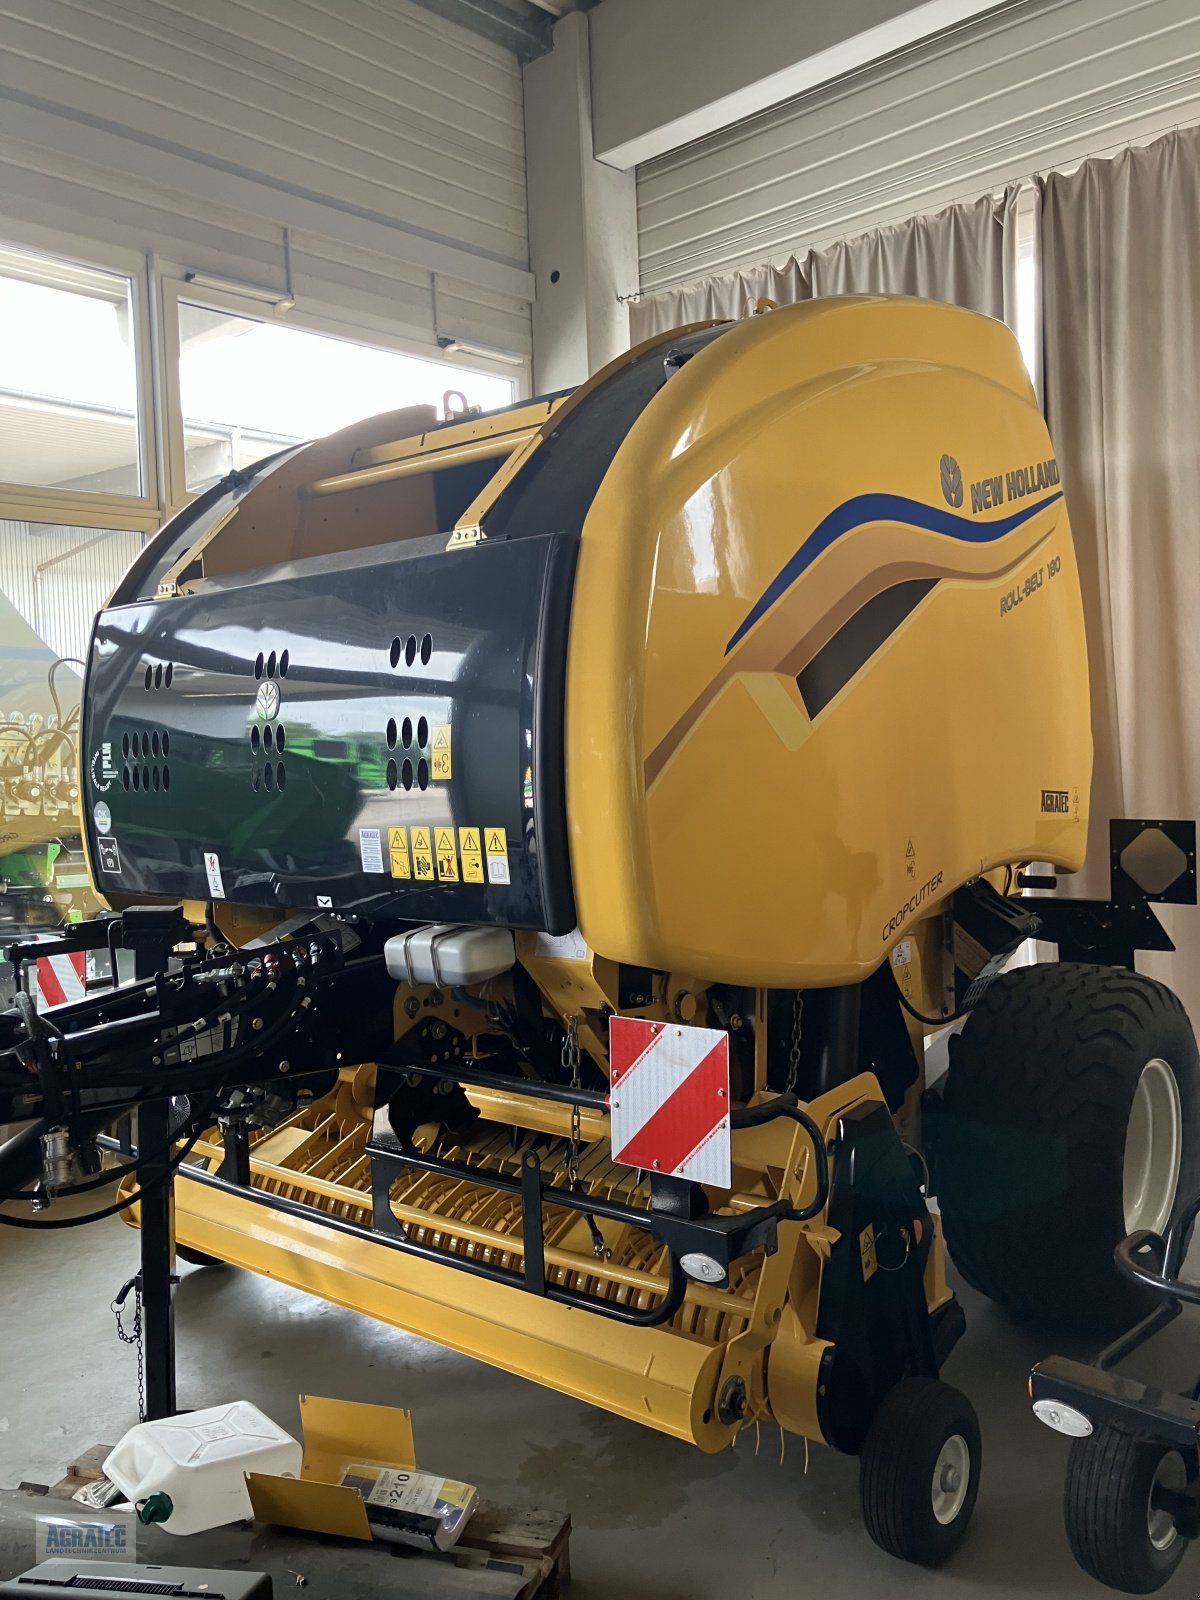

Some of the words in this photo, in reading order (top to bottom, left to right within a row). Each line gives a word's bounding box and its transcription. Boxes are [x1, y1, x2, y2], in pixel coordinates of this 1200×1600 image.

[970, 475, 1004, 514] NEW
[1005, 458, 1060, 502] HOLLAND
[1000, 567, 1044, 617] ROLL-BELT
[1046, 556, 1061, 580] 180
[102, 742, 112, 769] PLM
[97, 809, 108, 819] OK
[1040, 789, 1069, 813] AGRATEC
[882, 870, 944, 942] CROPCUTTER
